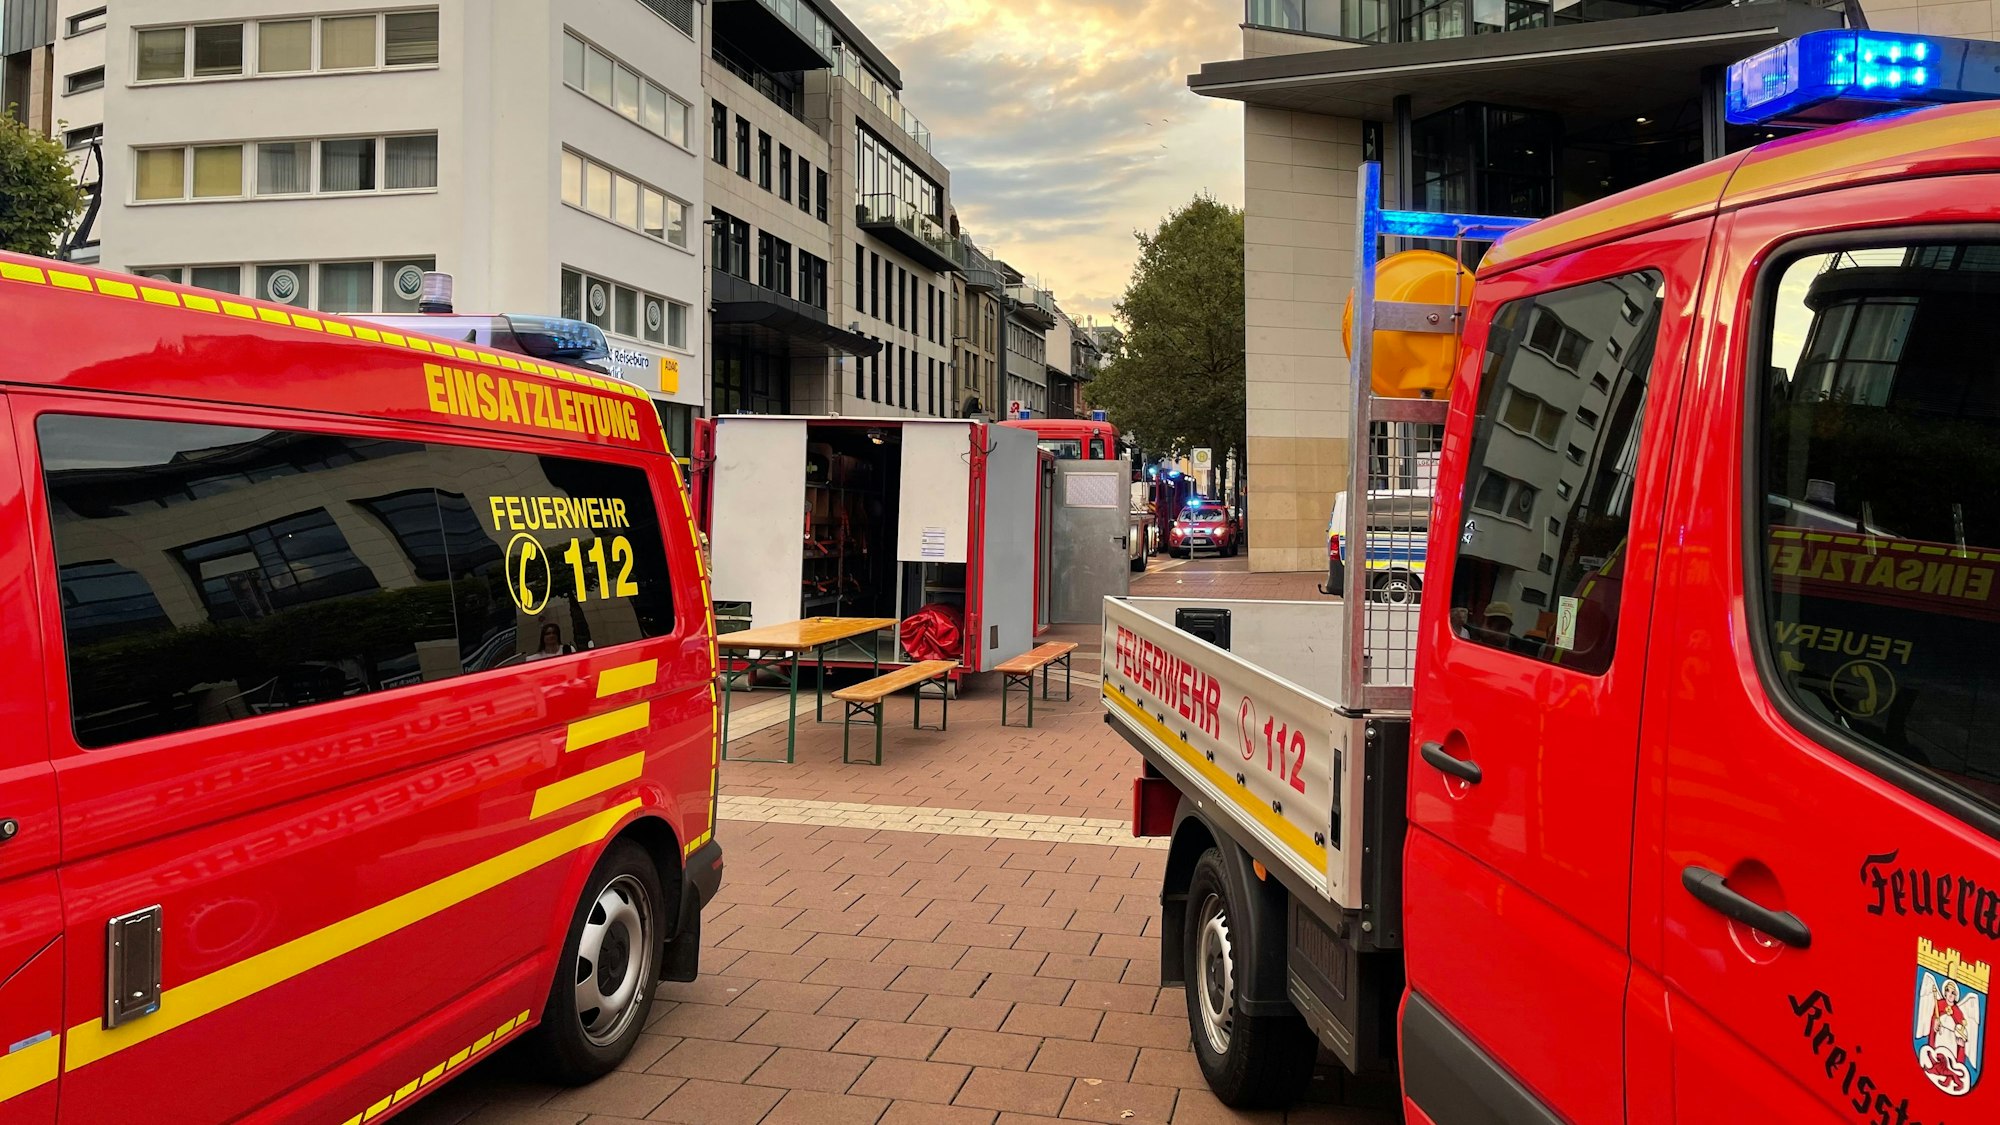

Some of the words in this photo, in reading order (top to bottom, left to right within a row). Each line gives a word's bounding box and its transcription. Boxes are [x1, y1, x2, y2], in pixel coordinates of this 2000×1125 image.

[614, 350, 649, 368] Reisebüro
[665, 360, 678, 372] ADAC
[423, 362, 640, 441] EINSATZLEITUNG
[489, 496, 630, 531] FEUERWEHR
[564, 535, 639, 603] 112
[1116, 624, 1221, 741] FEUERWEHR
[1263, 715, 1306, 795] 112
